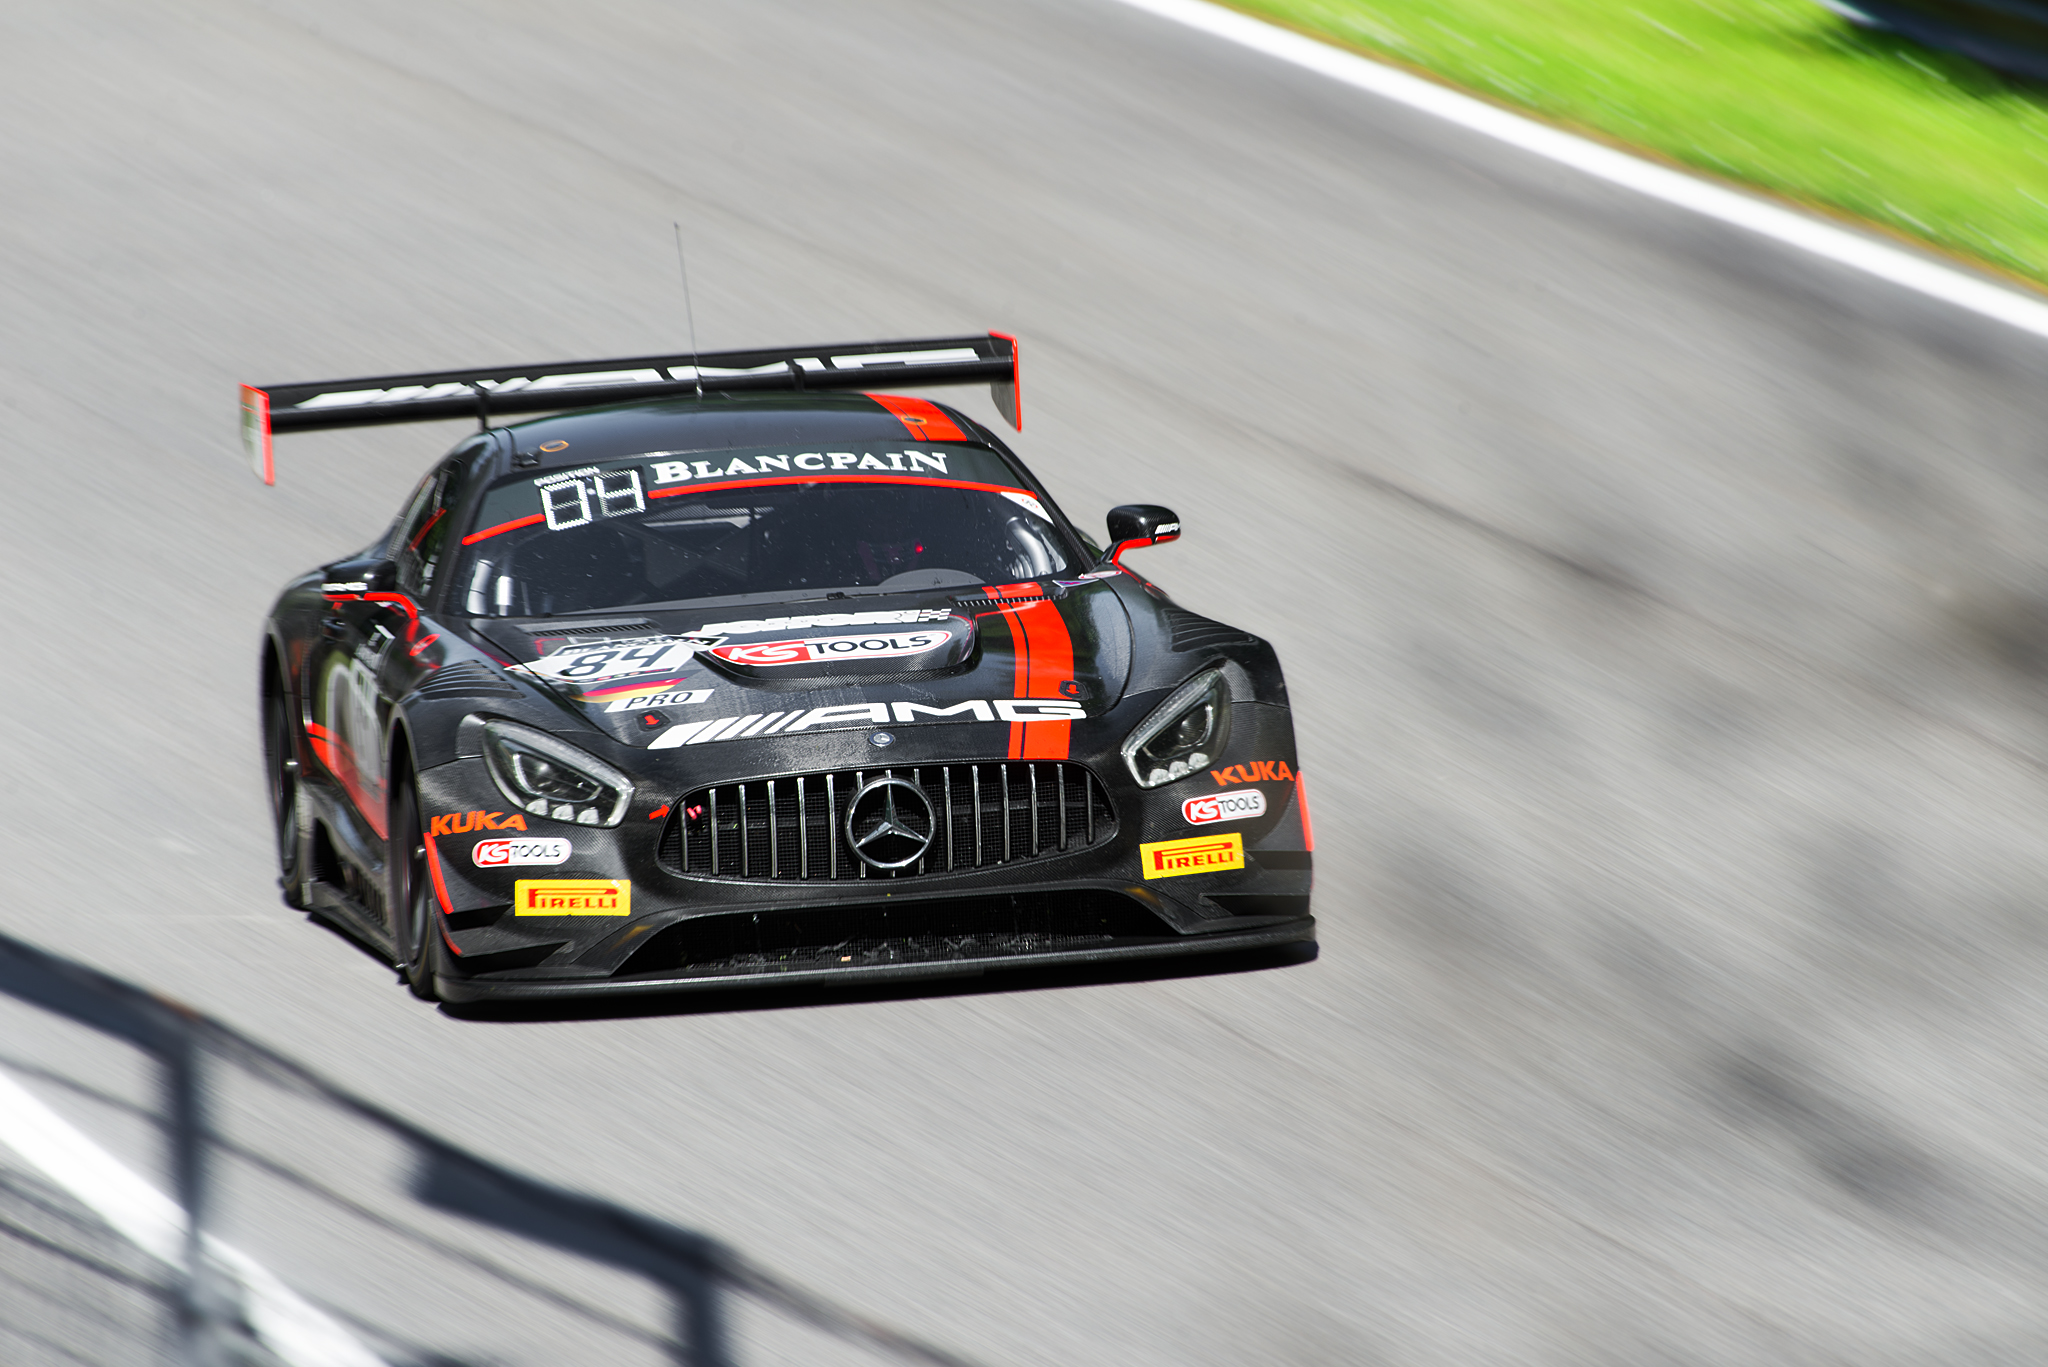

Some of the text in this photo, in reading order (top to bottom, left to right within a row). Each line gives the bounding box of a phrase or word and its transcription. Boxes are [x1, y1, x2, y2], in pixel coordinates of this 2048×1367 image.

[649, 450, 949, 485] BLANCPAIN
[561, 645, 674, 677] 84
[727, 635, 932, 662] KS TOOLS
[624, 691, 693, 709] PRO
[786, 700, 1087, 731] AMG
[1210, 760, 1295, 786] KUKA
[1190, 797, 1259, 820] KS TOOLS
[430, 810, 528, 837] KUKA
[479, 843, 562, 862] KS TOOLS
[1153, 841, 1234, 871] PIRELLI
[527, 887, 618, 909] PIRELLI
